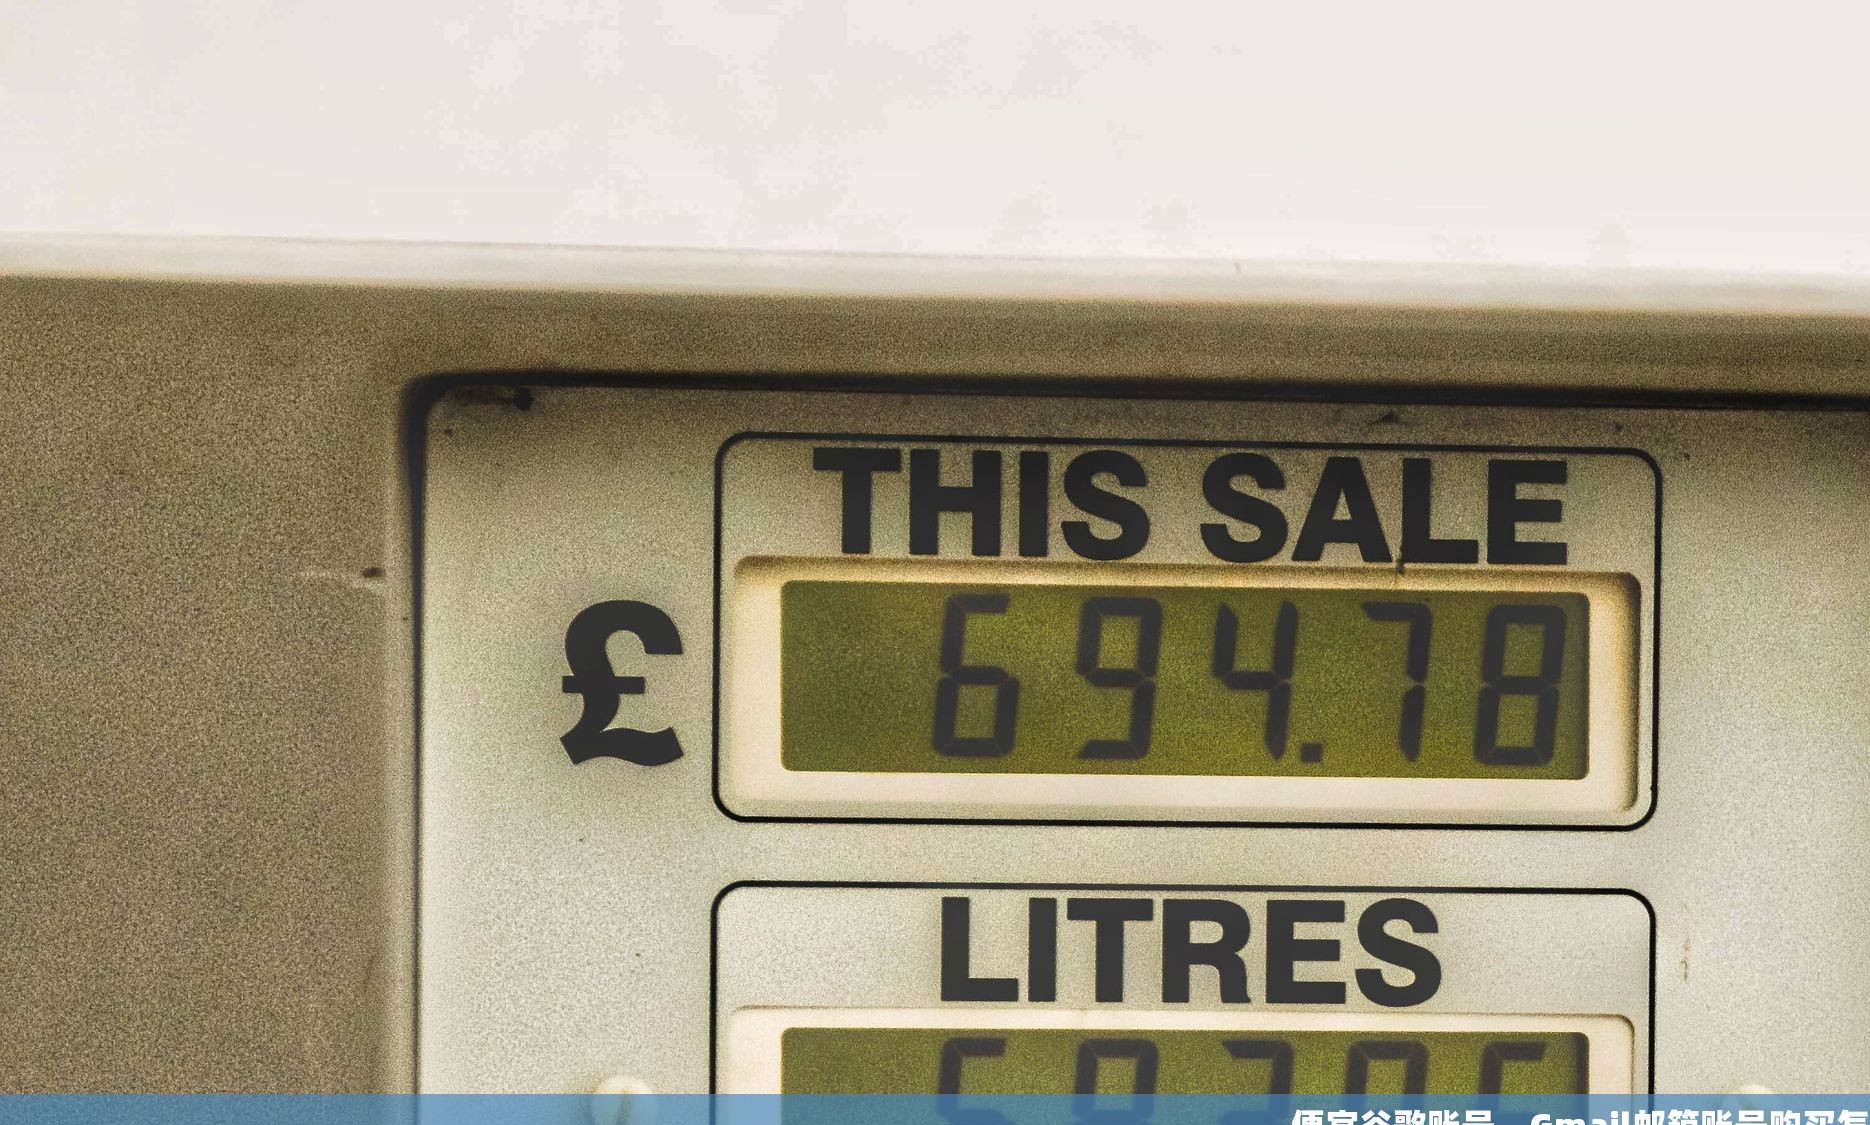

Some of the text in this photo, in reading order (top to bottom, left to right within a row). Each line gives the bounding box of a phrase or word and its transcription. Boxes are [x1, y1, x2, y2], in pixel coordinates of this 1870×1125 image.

[812, 447, 1568, 565] THIS SALE
[560, 599, 684, 767] £
[932, 594, 1568, 767] 694.78
[940, 896, 1442, 1008] LITRES
